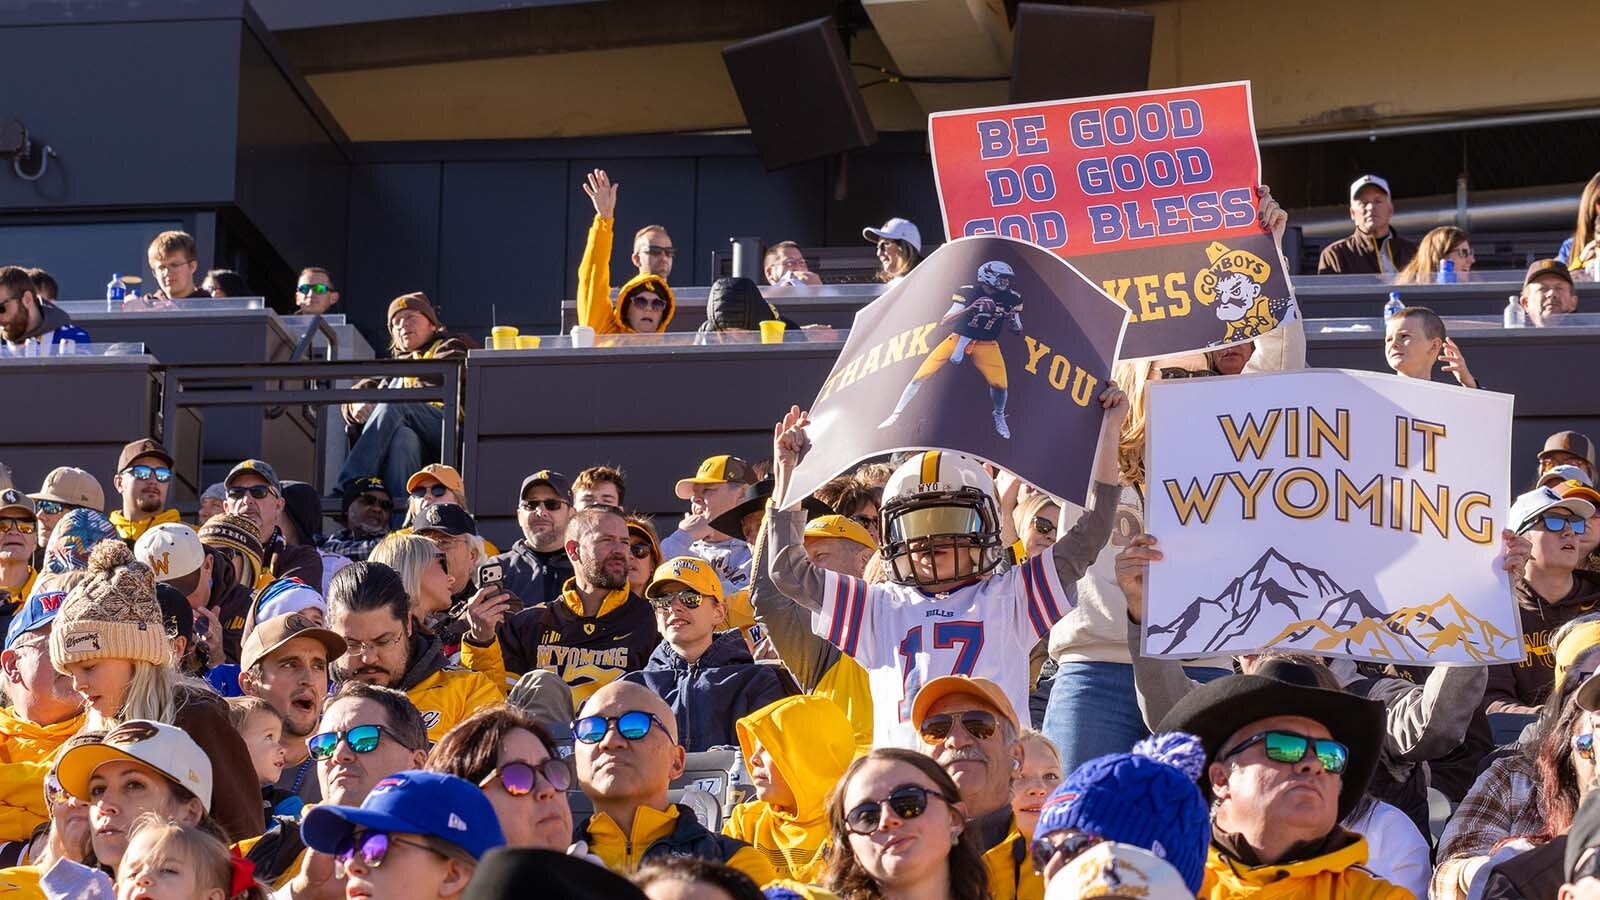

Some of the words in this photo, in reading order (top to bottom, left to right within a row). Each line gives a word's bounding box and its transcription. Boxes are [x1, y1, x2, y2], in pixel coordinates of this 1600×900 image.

[977, 115, 1049, 159] BE
[1069, 99, 1203, 149] GOOD
[985, 165, 1056, 207] DO
[1076, 146, 1212, 195] GOOD
[1088, 188, 1256, 244] BLESS
[1200, 255, 1264, 296] COWBOYS
[819, 322, 937, 403] THANK
[1023, 335, 1098, 408] YOU
[1217, 406, 1350, 462] WIN
[1395, 415, 1447, 473] IT
[918, 482, 938, 492] WYO
[1162, 467, 1494, 546] WYOMING
[148, 551, 169, 576] W
[748, 624, 762, 644] W
[925, 609, 954, 618] BILLS
[537, 645, 629, 668] WYOMING
[898, 620, 985, 724] 17
[697, 780, 715, 792] 17
